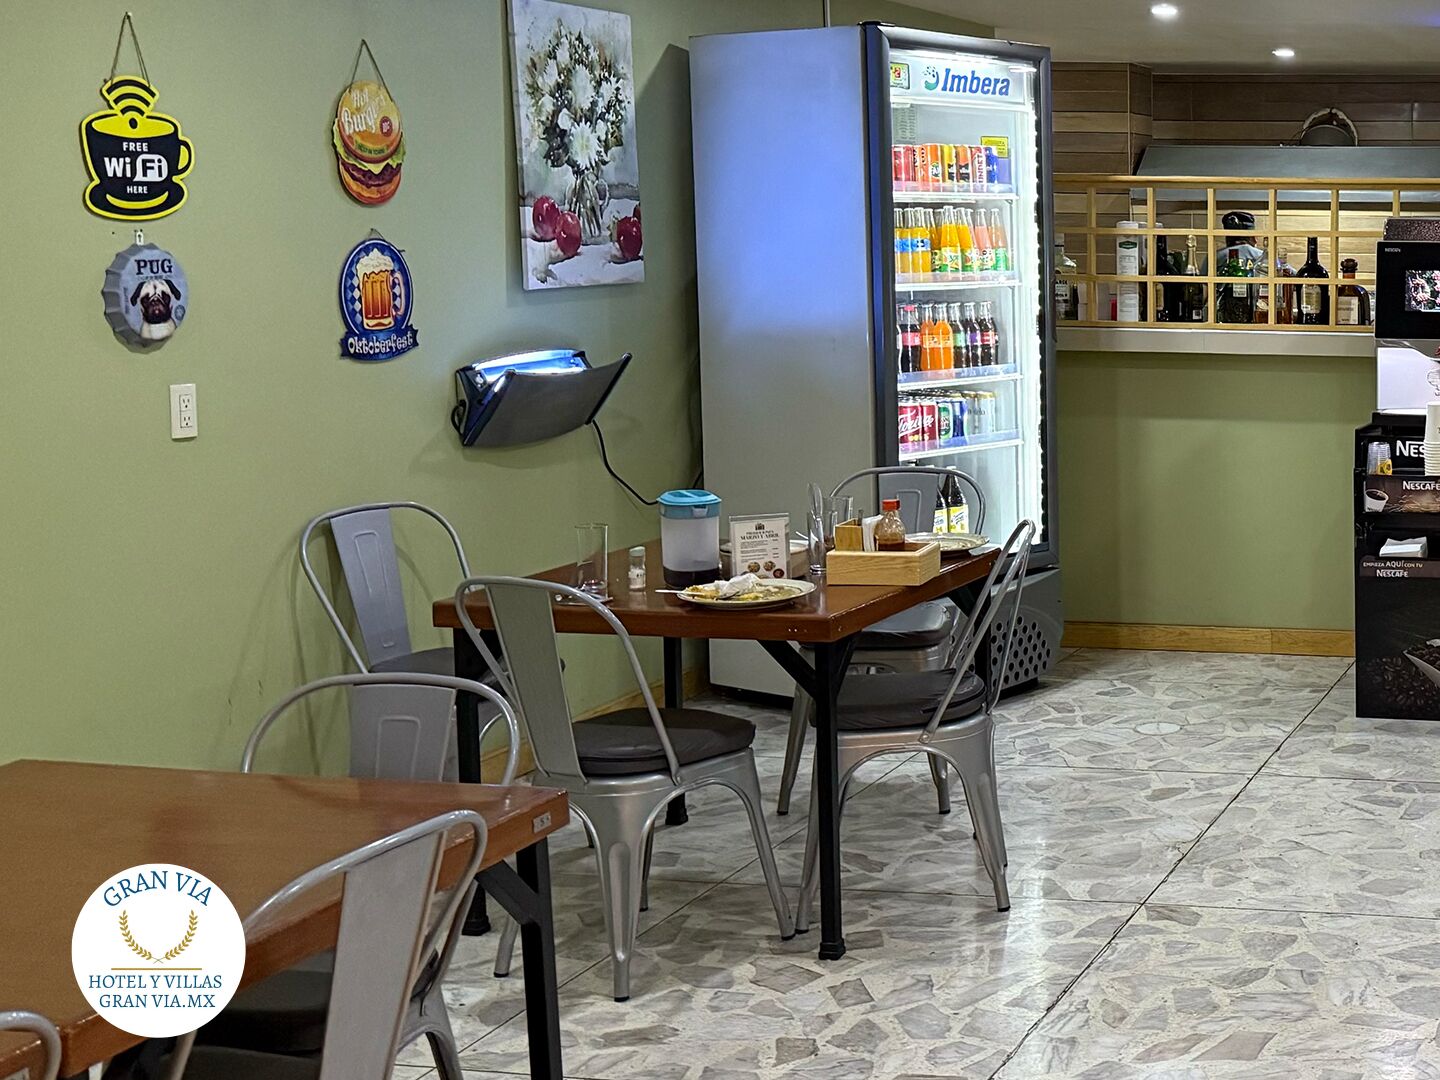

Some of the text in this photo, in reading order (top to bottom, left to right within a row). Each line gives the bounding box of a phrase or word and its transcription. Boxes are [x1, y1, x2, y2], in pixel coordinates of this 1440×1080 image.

[941, 68, 1010, 96] Imbera
[122, 142, 148, 152] FREE
[126, 186, 148, 194] HERE
[134, 259, 173, 275] PUG
[347, 330, 413, 354] Oktoberfest
